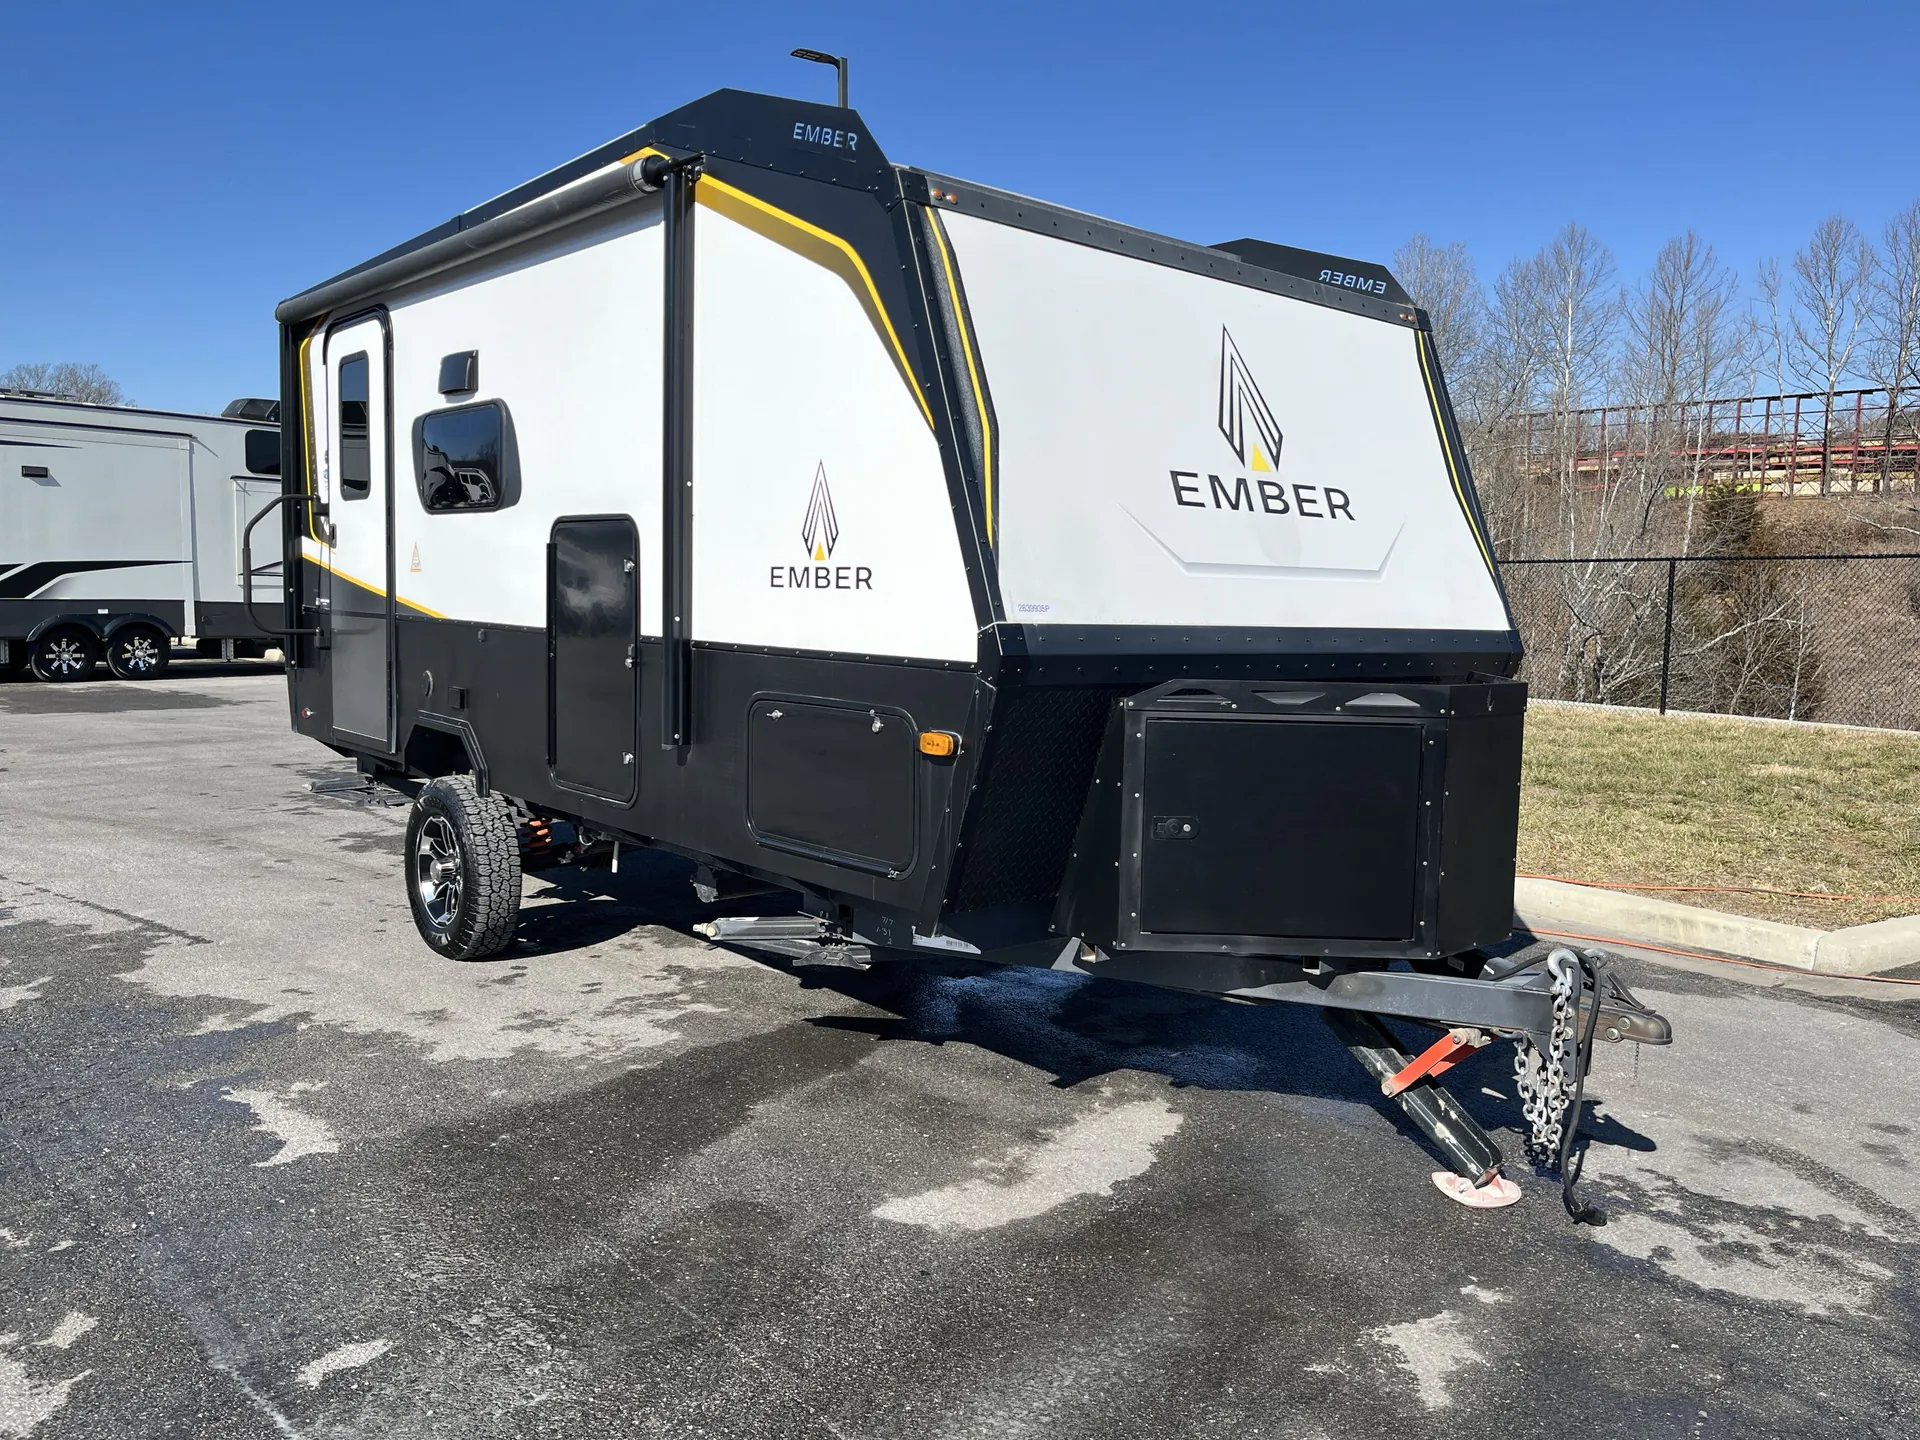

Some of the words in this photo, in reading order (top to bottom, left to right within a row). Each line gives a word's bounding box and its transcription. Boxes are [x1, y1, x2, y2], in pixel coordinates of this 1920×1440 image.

[793, 122, 858, 151] EMBER
[1169, 470, 1356, 521] EMBER
[770, 566, 872, 590] EMBER
